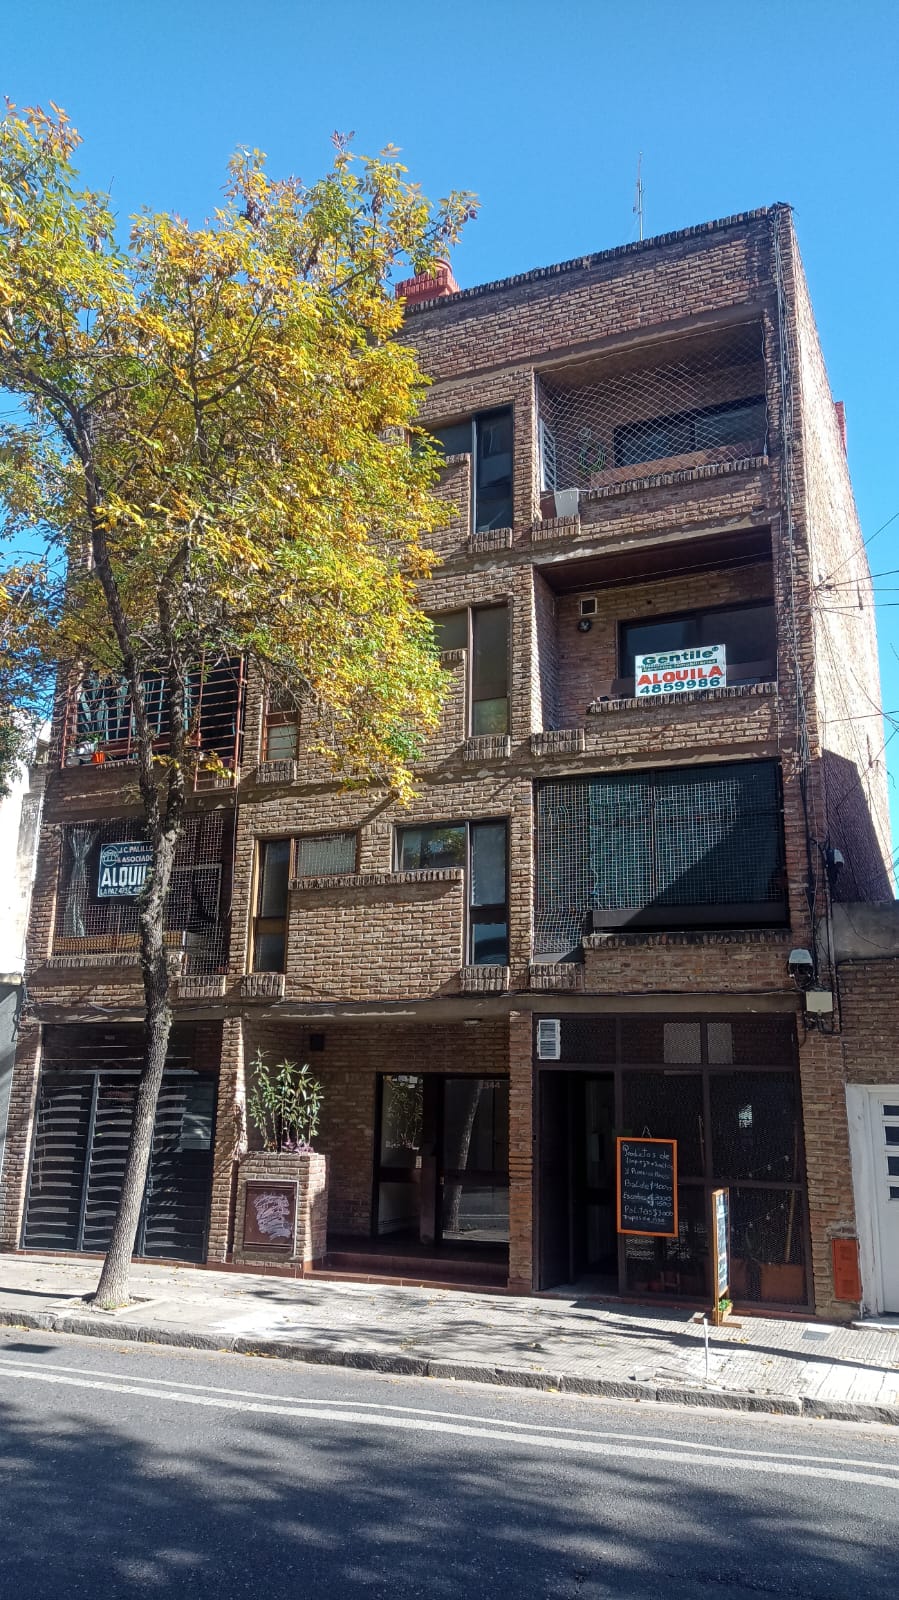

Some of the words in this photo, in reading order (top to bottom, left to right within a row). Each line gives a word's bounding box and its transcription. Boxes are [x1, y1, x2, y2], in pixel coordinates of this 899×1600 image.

[642, 650, 713, 665] Gentile
[637, 665, 723, 686] ALQUILA
[640, 677, 721, 694] 4859986
[101, 866, 146, 887] ALQUIL
